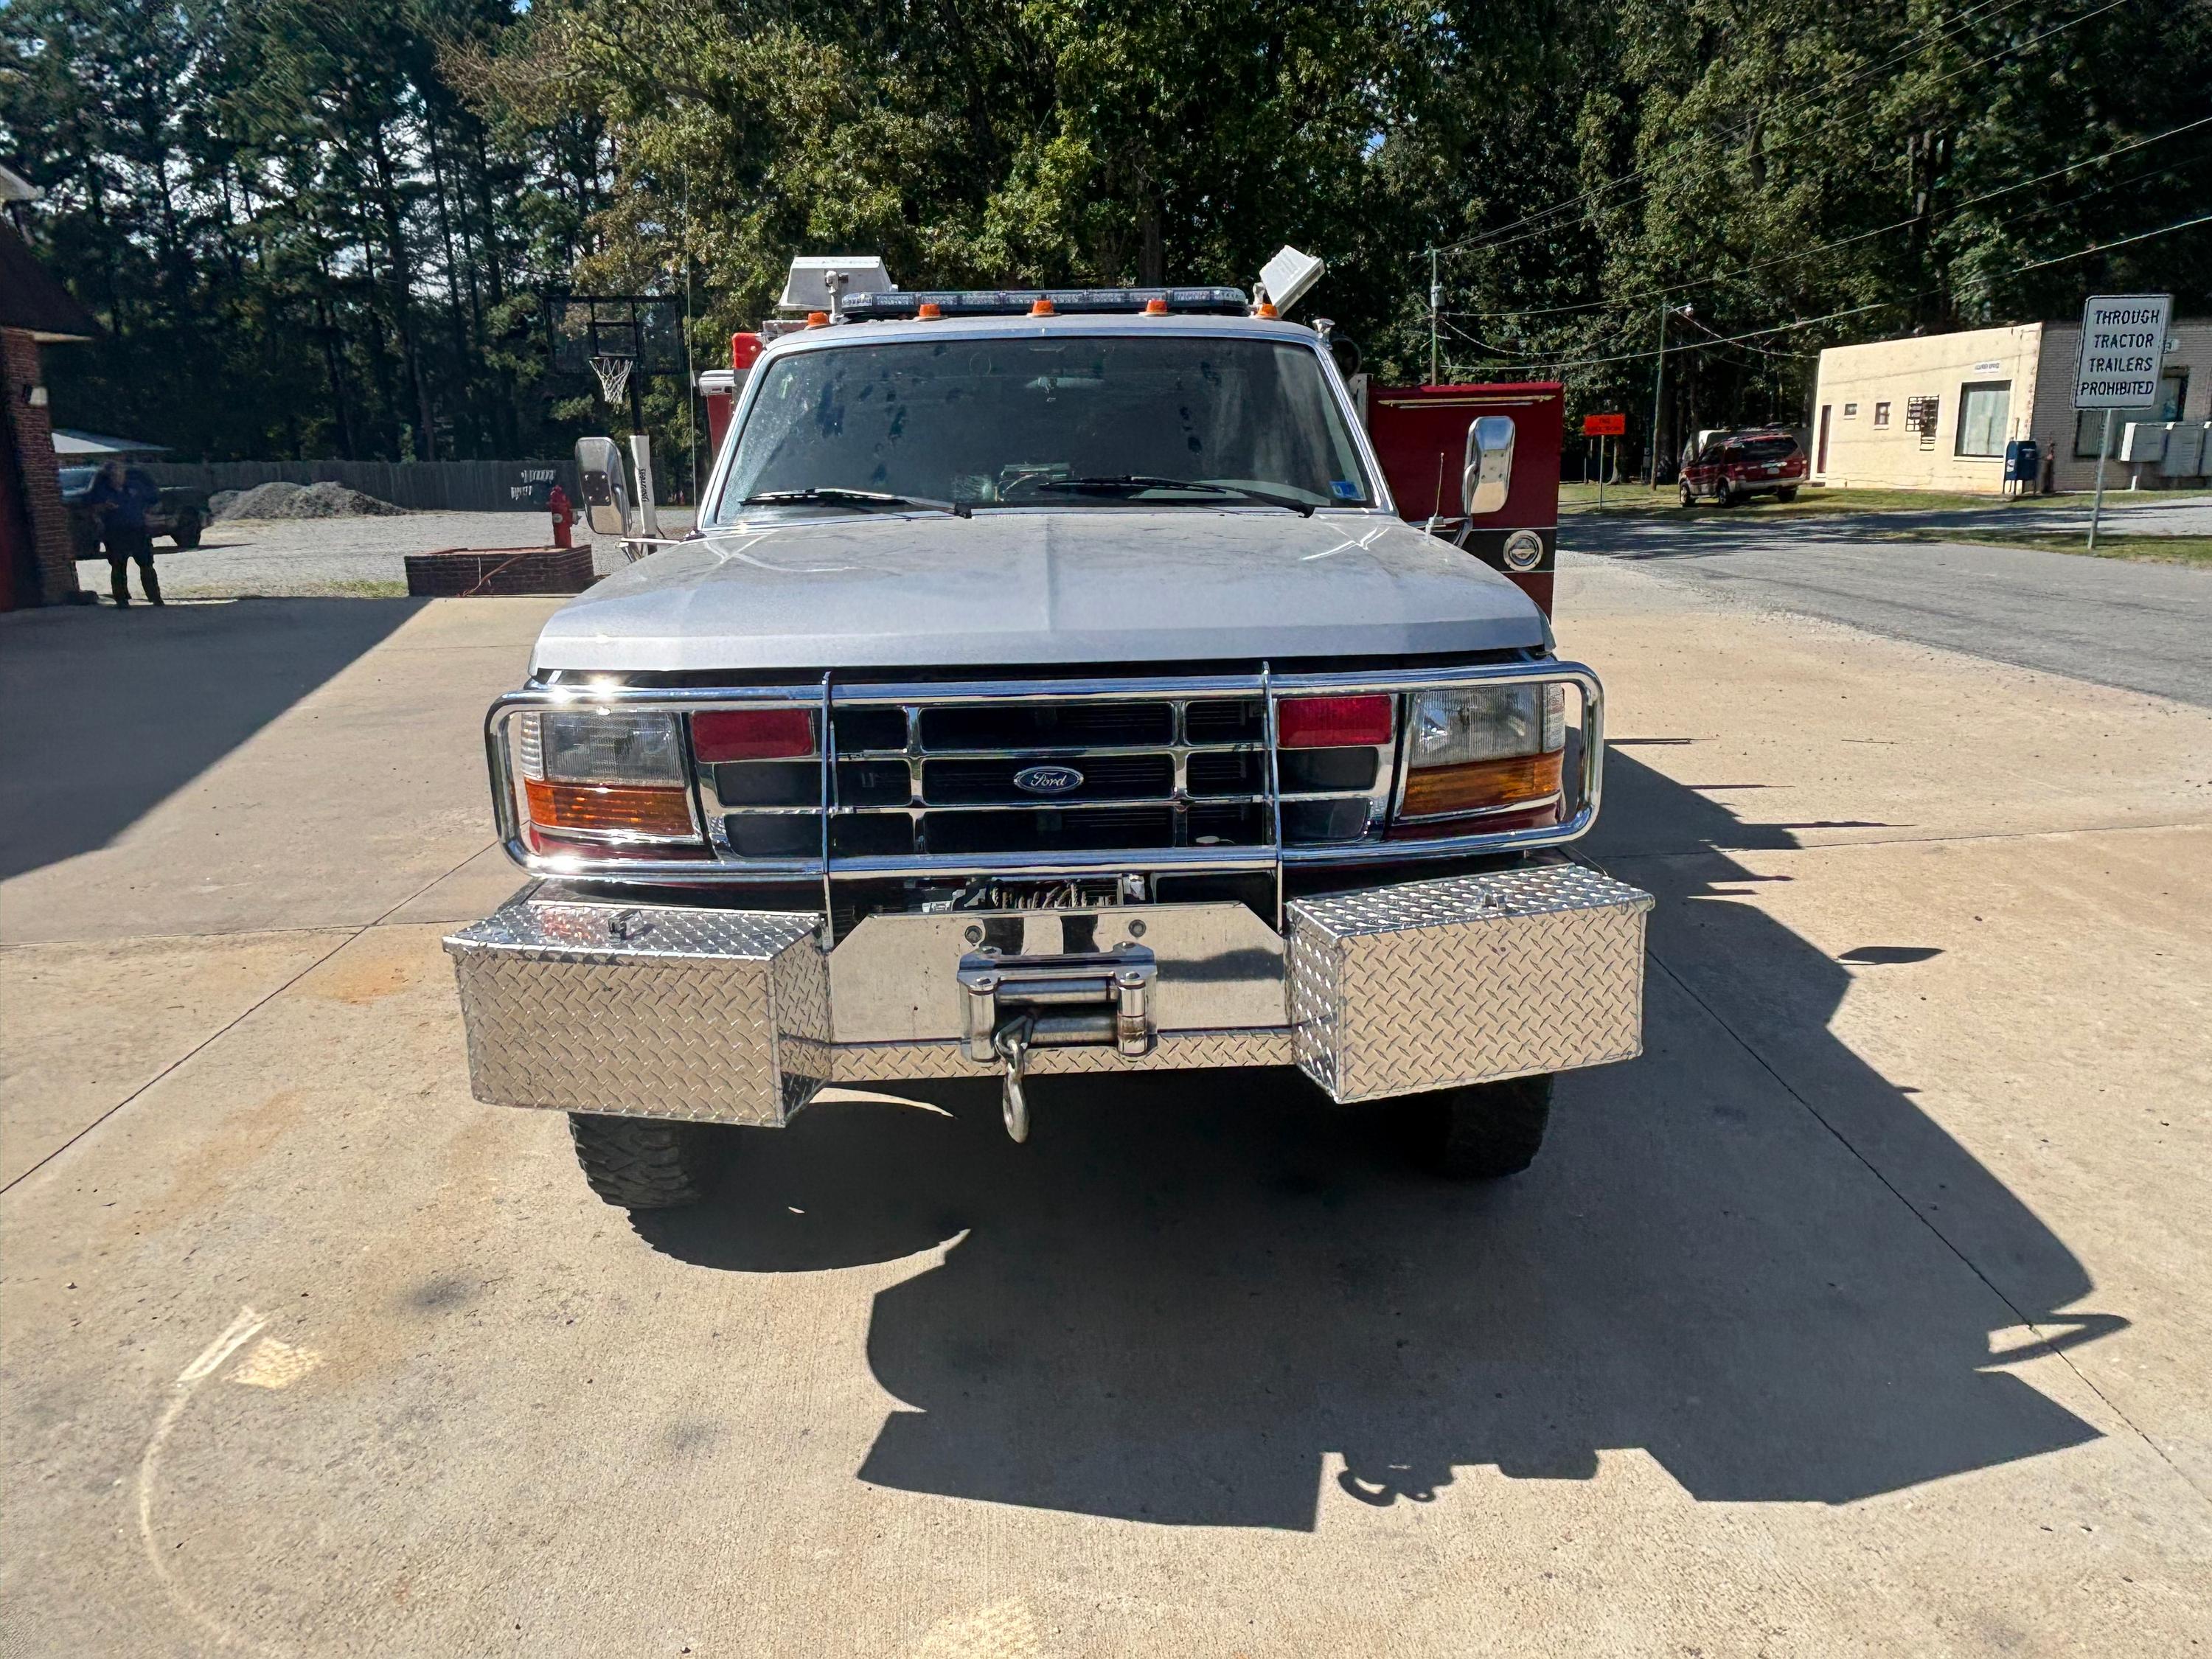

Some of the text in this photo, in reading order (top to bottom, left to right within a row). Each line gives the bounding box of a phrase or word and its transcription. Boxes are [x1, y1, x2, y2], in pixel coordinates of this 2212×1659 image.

[2096, 310, 2160, 325] THROUGH
[2094, 334, 2154, 348] TRACTOR
[2089, 358, 2153, 372] TRAILERS
[2081, 381, 2154, 395] PROHIBITED
[1030, 772, 1067, 786] Ford
